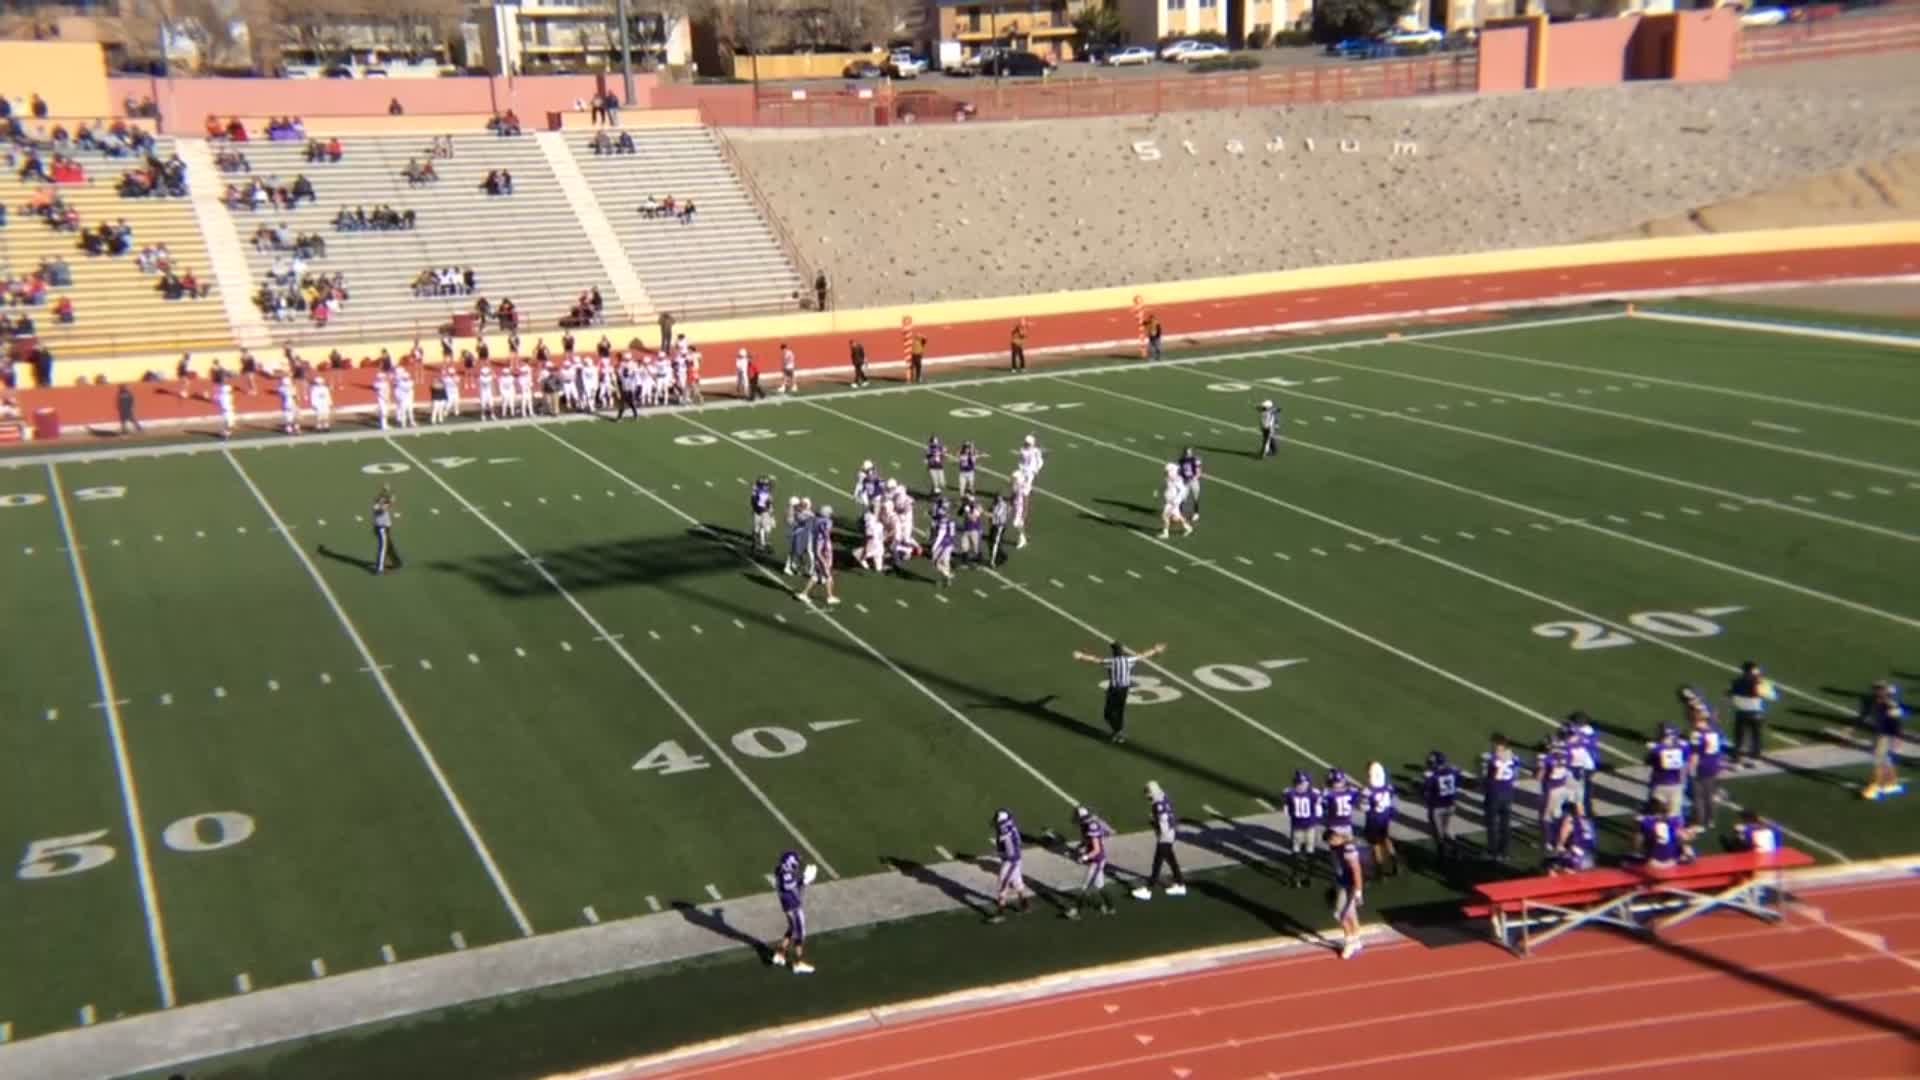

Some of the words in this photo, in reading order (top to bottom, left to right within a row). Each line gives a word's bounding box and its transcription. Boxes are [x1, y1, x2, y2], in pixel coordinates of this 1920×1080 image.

[1132, 135, 1418, 160] Stadium
[1531, 611, 1722, 651] 20
[1098, 663, 1272, 705] 30
[632, 726, 807, 775] 40
[1294, 796, 1312, 818] 10
[18, 811, 256, 881] 50
